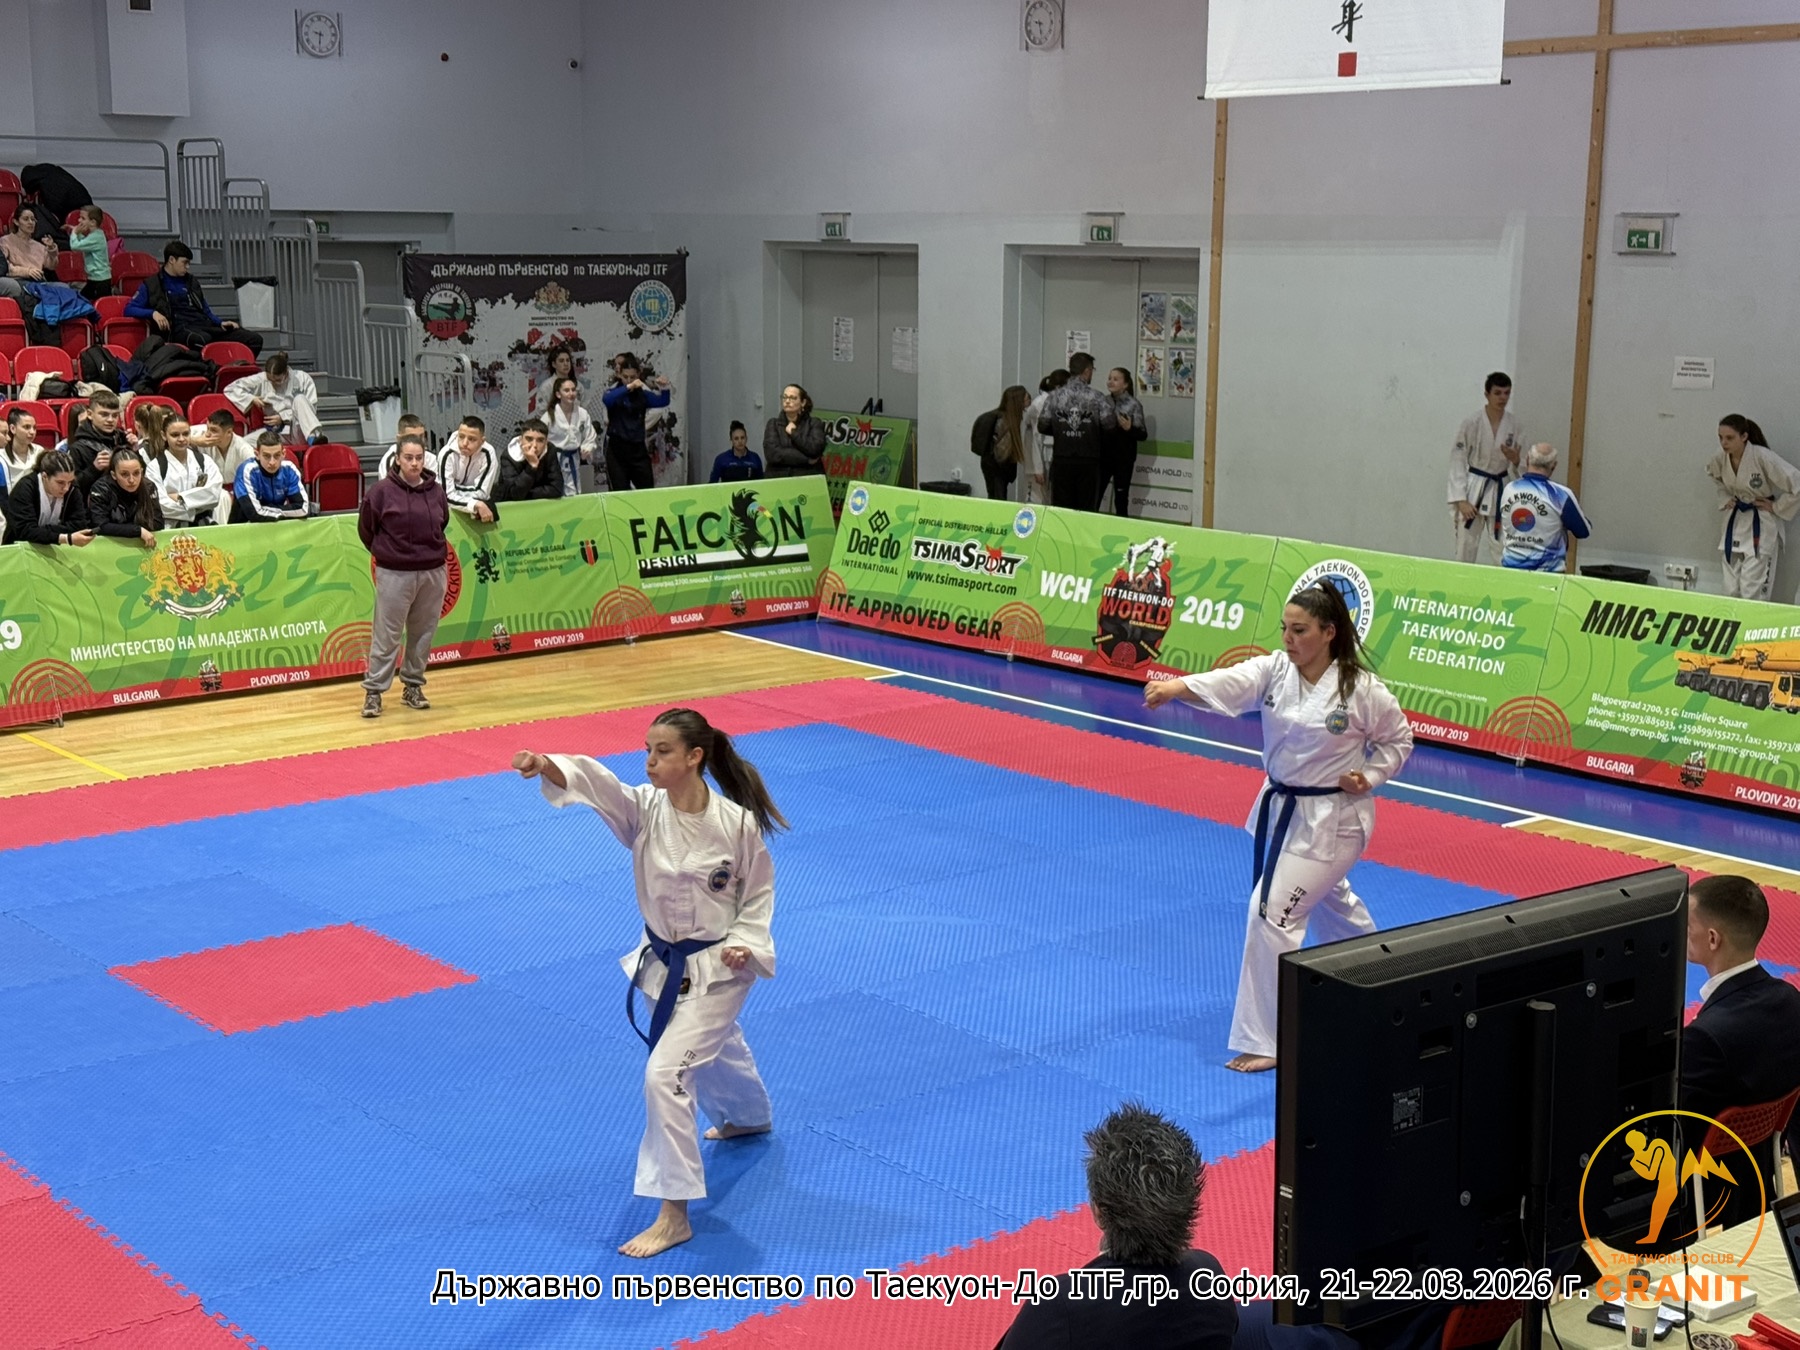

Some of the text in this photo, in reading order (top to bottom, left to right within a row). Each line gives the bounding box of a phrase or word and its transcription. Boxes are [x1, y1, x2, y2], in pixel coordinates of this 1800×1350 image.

[436, 322, 459, 332] BTF
[1162, 468, 1182, 477] HOLD
[1158, 501, 1178, 510] HOLD
[629, 504, 806, 556] FALCON
[918, 517, 943, 528] OFFICIAL
[985, 526, 1008, 537] HELLAS
[1526, 535, 1544, 544] Club
[505, 544, 566, 557] REPUBLIC OF BULGARIA
[637, 553, 698, 570] DESIGN
[841, 558, 899, 576] INTERNATIONAL
[441, 551, 460, 614] FFICKING
[907, 569, 1017, 596] www.tsimasport.com
[1040, 569, 1093, 604] WCH
[1314, 562, 1369, 598] TAEKWON-DO
[766, 600, 809, 613] PLOVDIV 2019
[1103, 586, 1174, 608] ITF TAEKWON-DO
[670, 612, 704, 625] BULGARIA
[829, 591, 1003, 641] ITF APPROVED GEAR
[1102, 597, 1172, 626] WORLD
[1179, 595, 1244, 631] 2019
[1393, 594, 1516, 629] INTERNATIONAL
[0, 619, 22, 651] 9
[1402, 619, 1506, 651] TAEKWON-DO
[1580, 599, 1742, 656] ММС-ГРУП
[1744, 626, 1778, 642] КОГАТО
[1780, 626, 1788, 639] Е
[70, 619, 327, 663] МИНИСТЕРСТВО НА МЛАДЕЖТА И СПОРТА
[534, 632, 585, 648] PLOVDIV 2019
[1051, 648, 1084, 665] BULGARIA
[1408, 645, 1506, 676] FEDERATION
[250, 669, 311, 688] PLOVDIV 2019
[113, 687, 161, 705] BULGARIA
[1591, 692, 1748, 731] Blagoevgrad 2700, 5 G. Izmirliev Square
[1410, 720, 1469, 742] PLOVDIV 2019
[1588, 704, 1616, 721] phone:
[1744, 733, 1761, 746] fax:
[1585, 716, 1781, 765] info@mmc-group.bg, web: www.mmc-group.bg
[1586, 755, 1635, 776] BULGARIA
[1734, 785, 1782, 806] PLOVDIV
[1294, 886, 1307, 897] ITF
[684, 1049, 697, 1061] ITF
